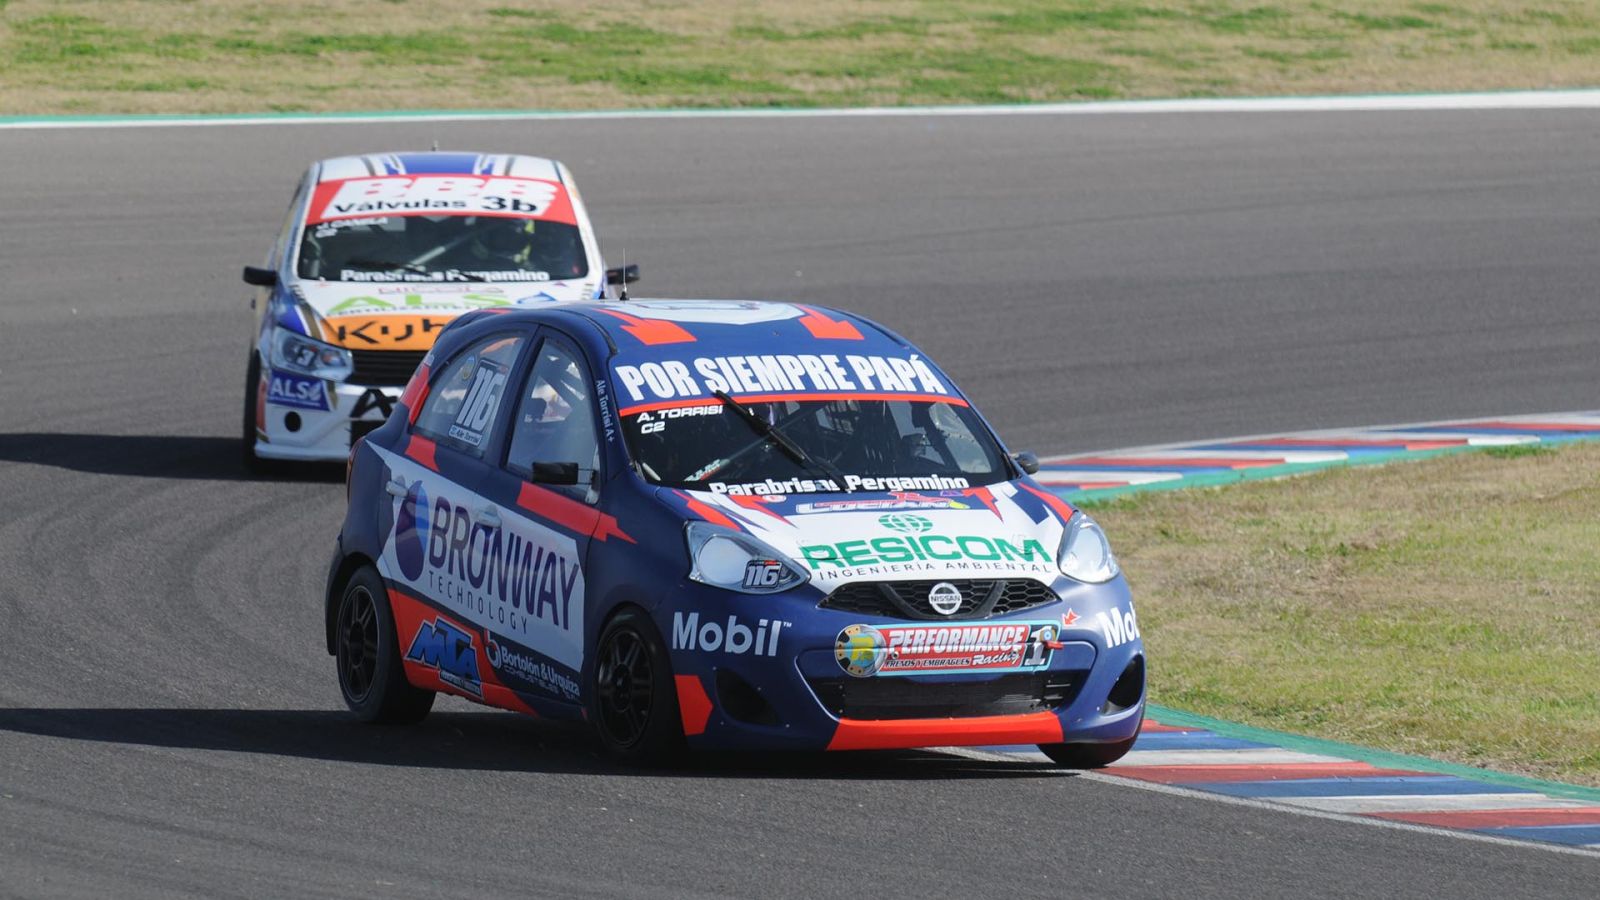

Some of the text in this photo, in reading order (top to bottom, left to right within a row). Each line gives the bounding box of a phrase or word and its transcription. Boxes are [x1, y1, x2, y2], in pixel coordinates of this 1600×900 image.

[482, 196, 538, 213] 3b
[269, 377, 310, 400] ALS
[615, 354, 948, 401] POR SIEMPRE PAPÁ
[455, 366, 506, 431] 116
[657, 405, 723, 419] TORRISI
[640, 421, 665, 434] C2
[845, 473, 970, 492] Pergamino
[429, 496, 580, 631] BRONWAY
[798, 535, 1053, 572] RESICOM
[745, 565, 780, 586] 116
[945, 561, 1053, 574] AMBIENTAL
[428, 571, 528, 635] TECHNOLOGY
[672, 611, 782, 656] Mobil
[888, 626, 1025, 654] PERFORMANCE
[971, 651, 1020, 666] Racing
